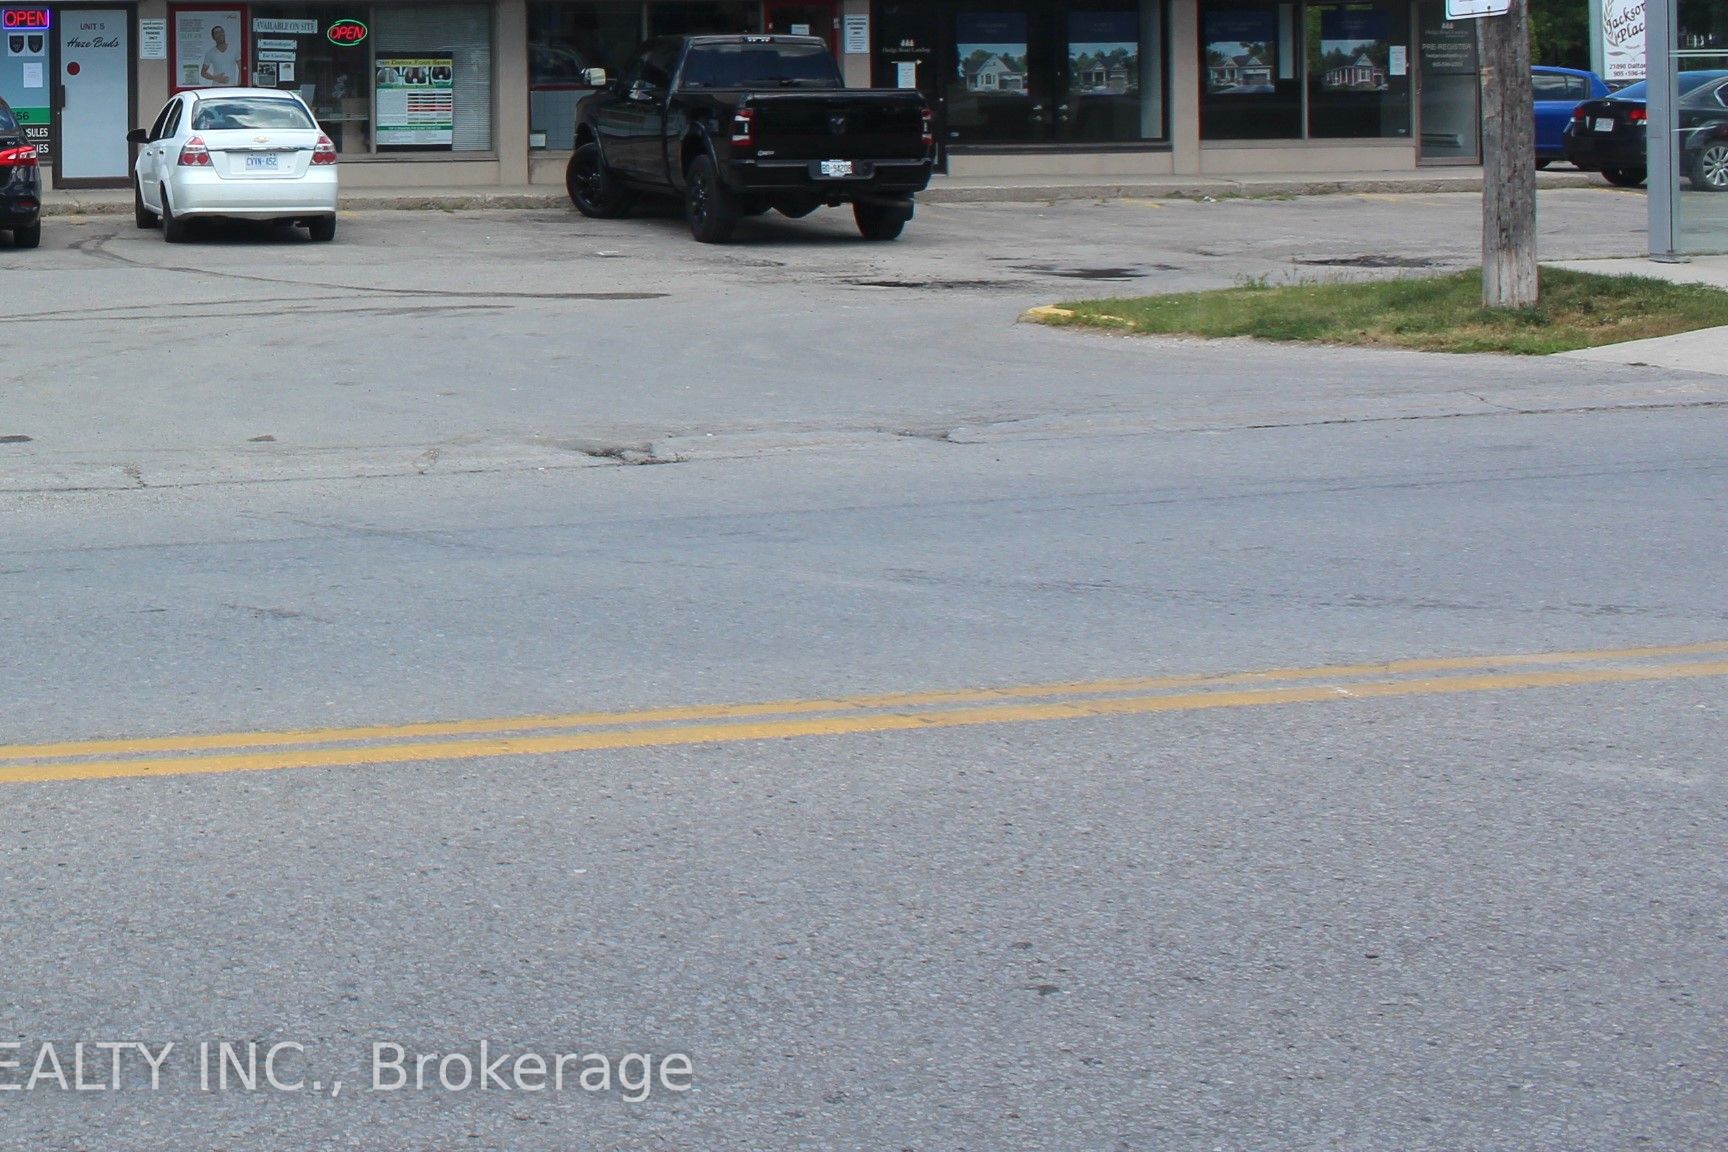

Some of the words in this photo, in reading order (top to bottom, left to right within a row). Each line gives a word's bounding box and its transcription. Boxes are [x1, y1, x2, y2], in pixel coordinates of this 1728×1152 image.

[5, 10, 48, 26] OPEN
[80, 23, 97, 31] UNIT
[330, 24, 365, 40] OPEN
[67, 36, 90, 48] Haze
[92, 35, 120, 48] Buds
